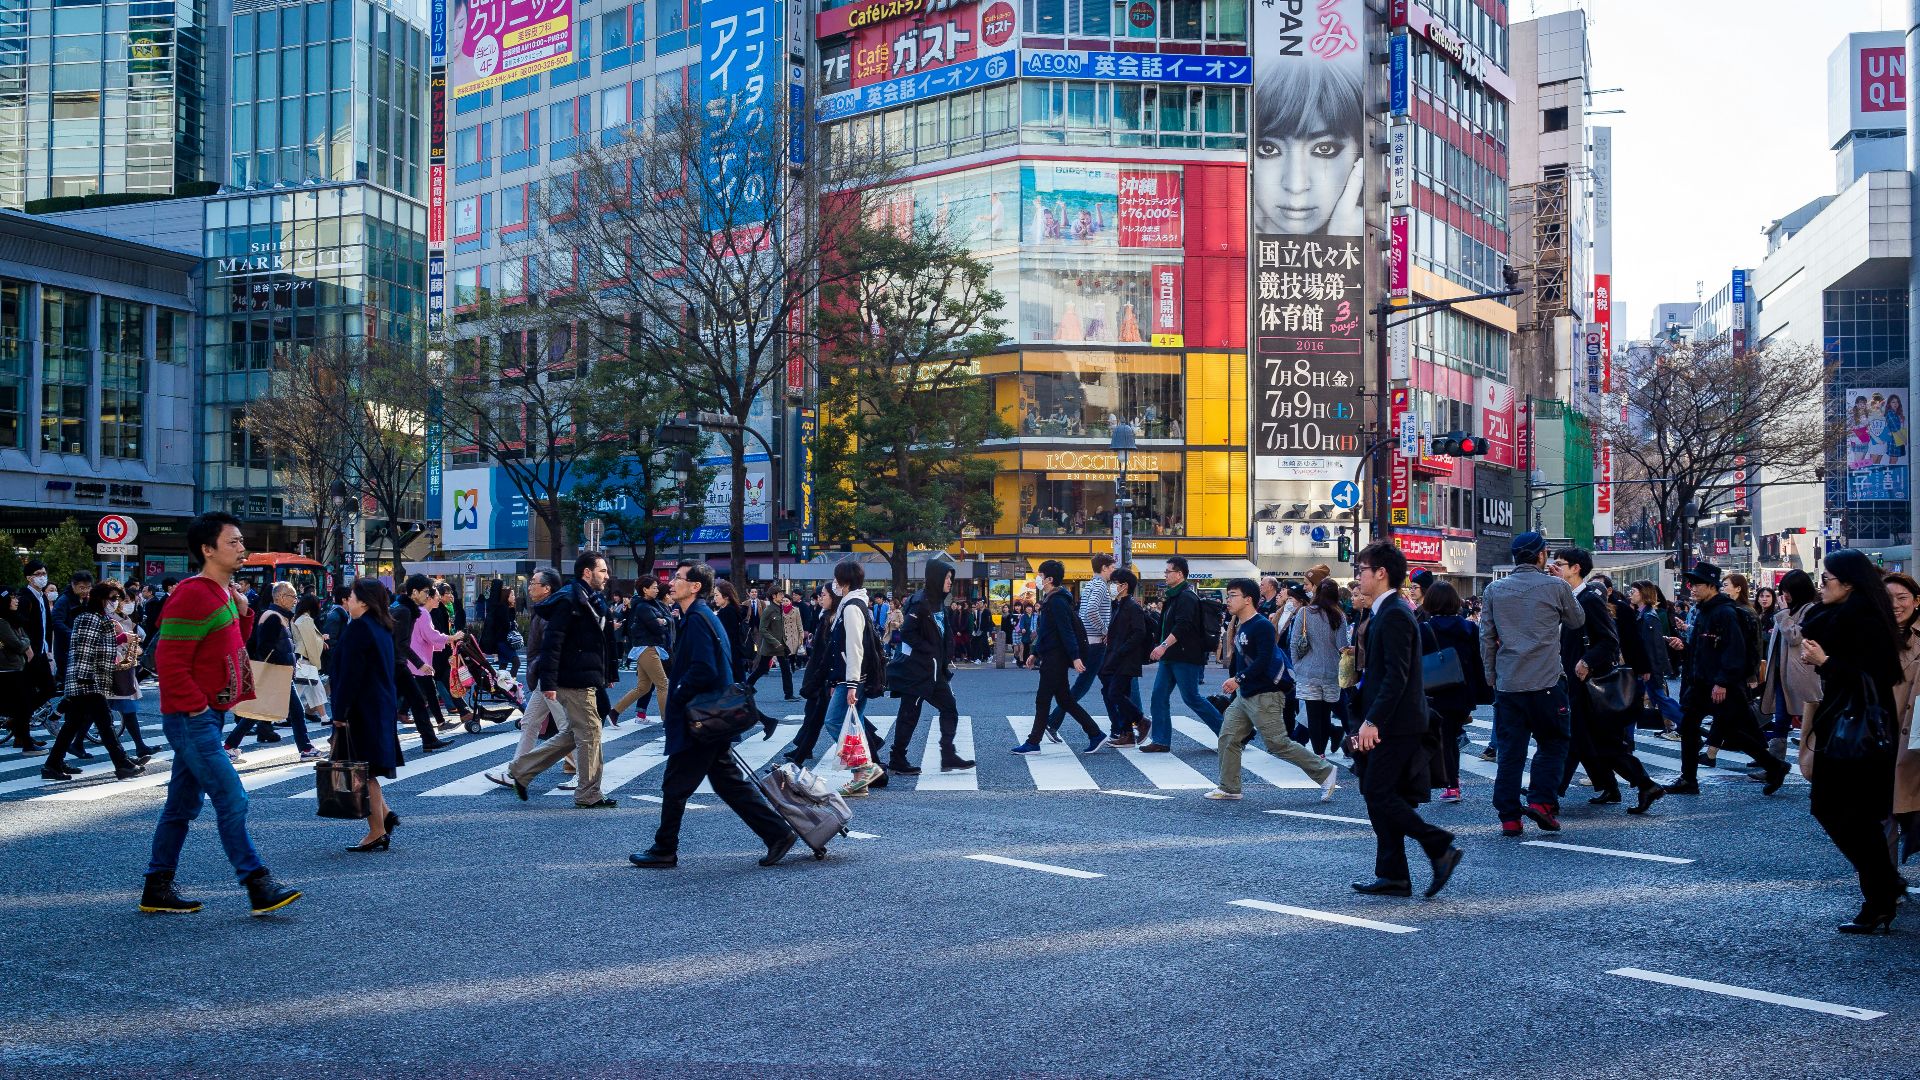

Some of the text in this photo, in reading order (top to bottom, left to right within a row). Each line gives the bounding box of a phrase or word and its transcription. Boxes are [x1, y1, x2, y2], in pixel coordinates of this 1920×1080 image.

[794, 0, 802, 42] ルーム
[1395, 0, 1404, 17] ト
[434, 0, 444, 52] 急リバブル
[986, 20, 1012, 36] ガスト
[1312, 0, 1357, 58] み
[858, 42, 889, 66] Café
[892, 21, 971, 74] ガスト
[479, 59, 493, 72] 4F
[823, 54, 850, 82] 7F
[858, 62, 889, 79] レストラン
[988, 60, 1006, 75] 6F
[1030, 54, 1248, 79] AEON 英会話イーオン
[1395, 43, 1404, 107] 英会話イーオン
[866, 65, 979, 108] 英会話イーオン
[744, 7, 765, 202] コンタクトの
[1395, 132, 1404, 199] 渋谷駅前ビル
[433, 166, 442, 207] 外貨両替
[1120, 176, 1158, 196] 沖縄
[1392, 217, 1407, 226] 5F
[251, 239, 316, 253] SHIBUYA
[1259, 240, 1360, 269] 国立代々木
[217, 249, 354, 273] MARK CITY
[253, 281, 312, 293] 渋谷 マークシティ
[430, 261, 443, 326] 加藤眼科
[1258, 272, 1362, 300] 競技場第一
[1597, 287, 1608, 310] 免税
[1159, 271, 1175, 328] 毎日開催
[1335, 301, 1351, 322] 3
[1259, 303, 1325, 331] 体育館
[1330, 315, 1359, 336] Days!
[1159, 337, 1176, 346] 4F
[1296, 340, 1324, 350] 2016
[1265, 359, 1354, 387] 7月8日(金)
[1265, 391, 1354, 419] 7月9日(土)
[1261, 422, 1359, 451] 7月10日(日)
[1489, 415, 1508, 439] アコム
[511, 519, 528, 527] SUMIT
[1394, 510, 1406, 523] 薬
[1483, 498, 1512, 527] LUSH
